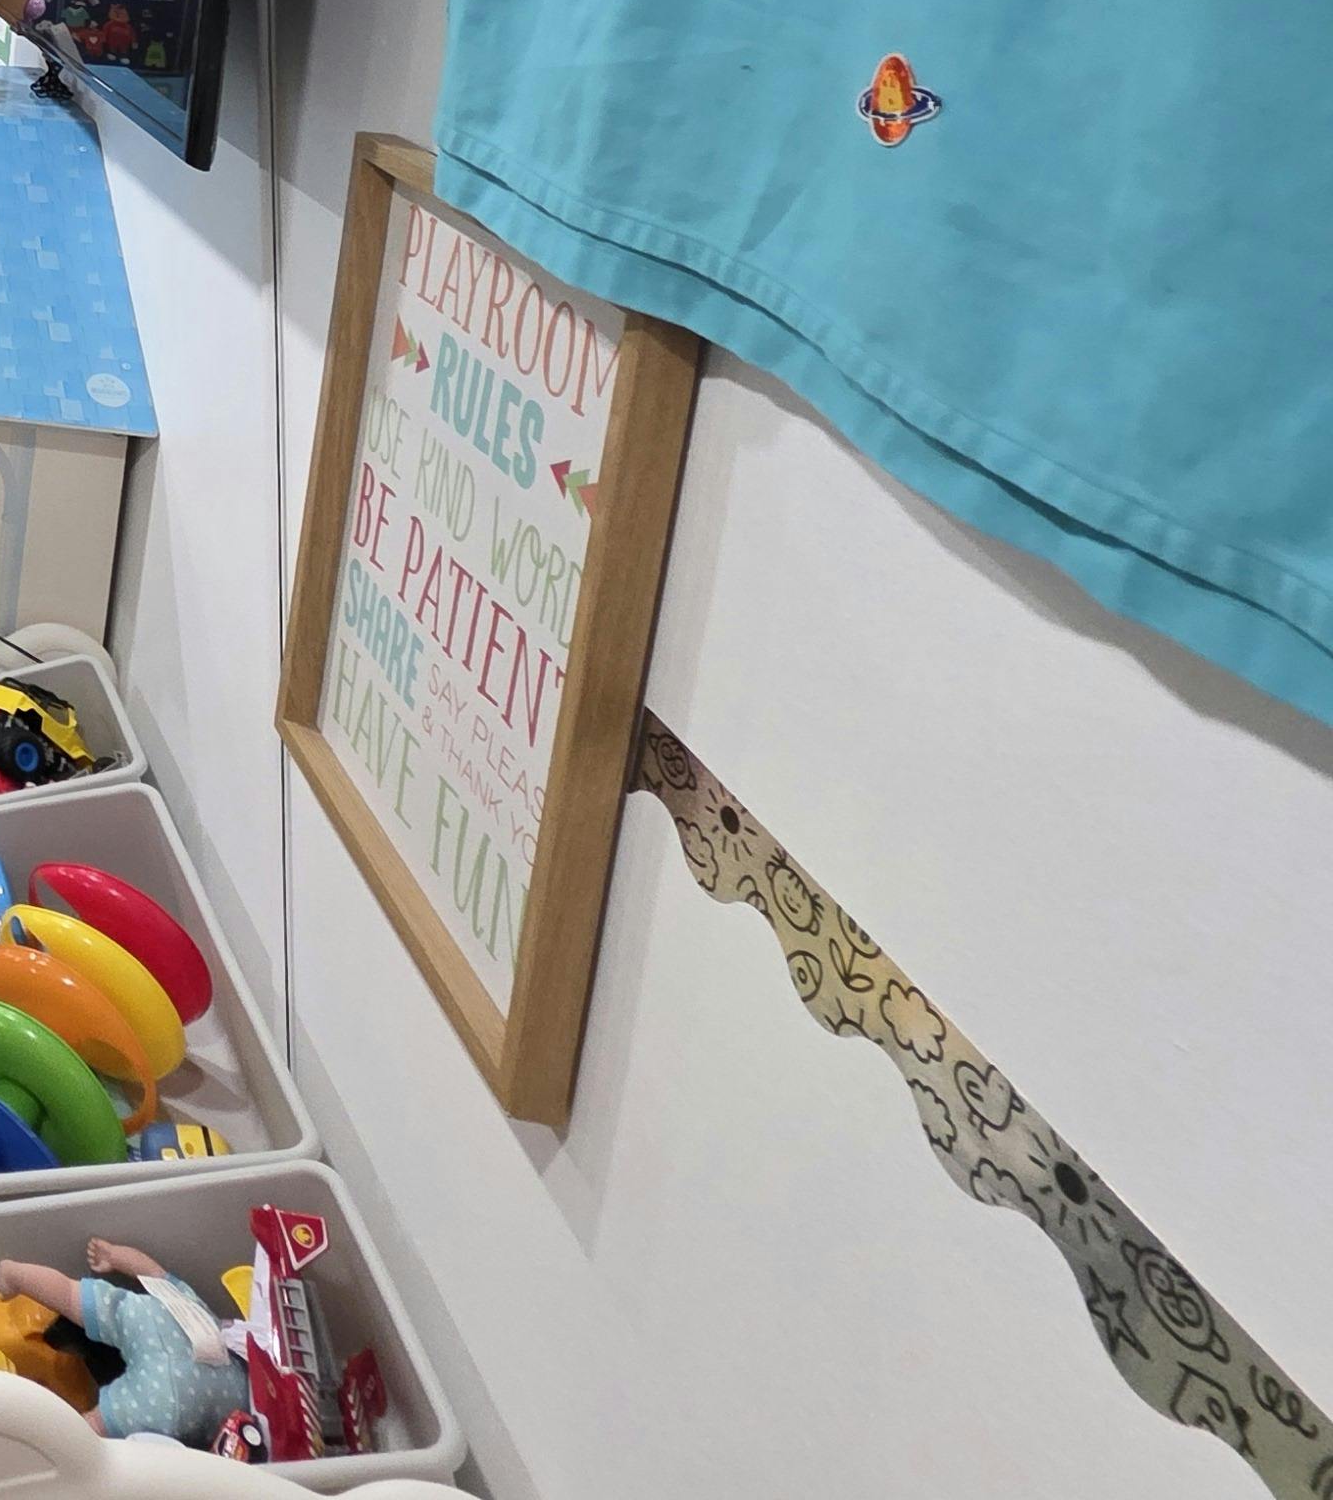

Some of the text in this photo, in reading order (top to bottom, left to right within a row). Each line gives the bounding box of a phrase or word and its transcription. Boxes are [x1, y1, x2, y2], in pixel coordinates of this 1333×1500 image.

[398, 203, 620, 417] PLAYROOM
[429, 331, 546, 490] RULES
[353, 462, 396, 572] BE
[414, 428, 475, 542] KIND
[344, 557, 425, 711] SHARE
[428, 662, 468, 725] SAY
[332, 638, 421, 831] HAVE
[421, 705, 435, 738] &
[438, 724, 503, 825] THANK
